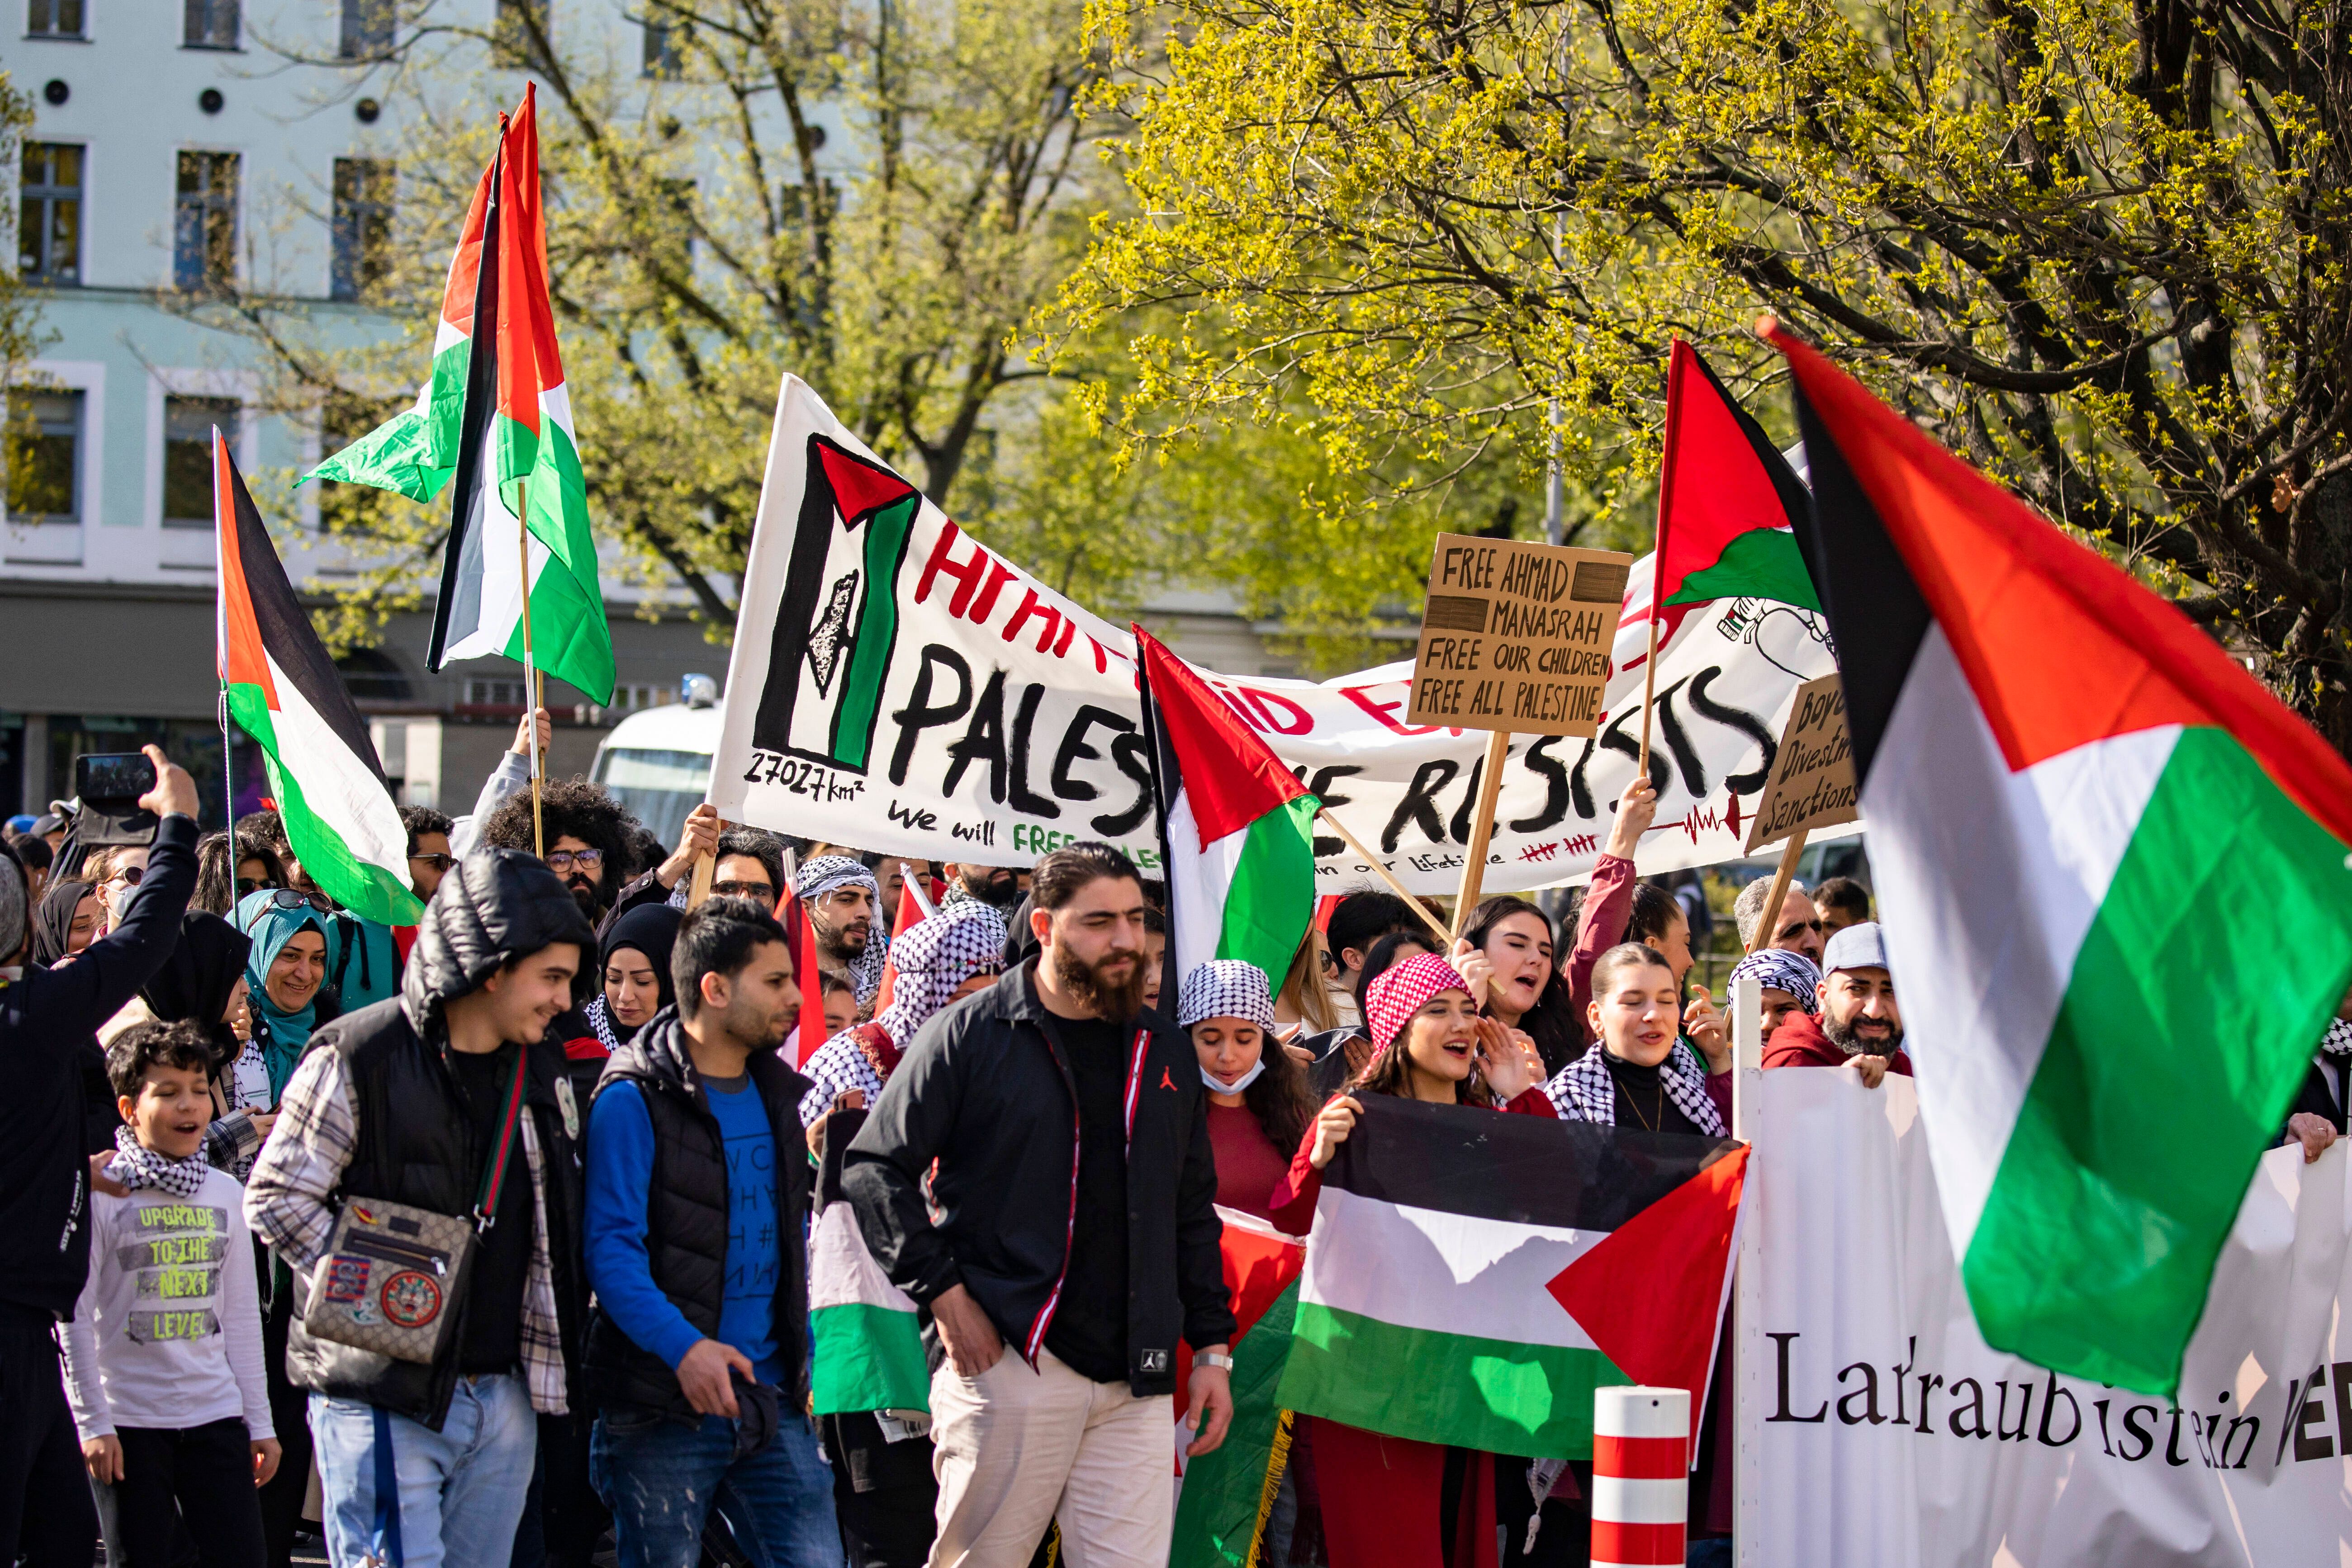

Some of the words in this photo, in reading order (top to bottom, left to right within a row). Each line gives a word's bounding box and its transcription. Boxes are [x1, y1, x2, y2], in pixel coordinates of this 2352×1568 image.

[1442, 547, 1497, 589] FREE
[1500, 552, 1568, 603] AHMAD
[1490, 600, 1603, 645] MANASRAH
[1425, 637, 1482, 670] FREE
[1494, 644, 1531, 673] OUR
[1538, 648, 1610, 676] CHILDREN
[1417, 678, 1464, 714] FREE
[1469, 680, 1504, 715] ALL
[1513, 682, 1601, 722] PALESTINE
[1796, 690, 1846, 735] Boyc
[1778, 725, 1853, 786] Divestm
[1762, 775, 1859, 837] Sanctions
[952, 820, 995, 847] will
[1354, 861, 1396, 872] or
[139, 1205, 216, 1227] UPGRADE
[149, 1240, 172, 1264] TO
[176, 1236, 210, 1264] THE
[159, 1270, 208, 1297] NEXT
[154, 1312, 206, 1339] LEVEL
